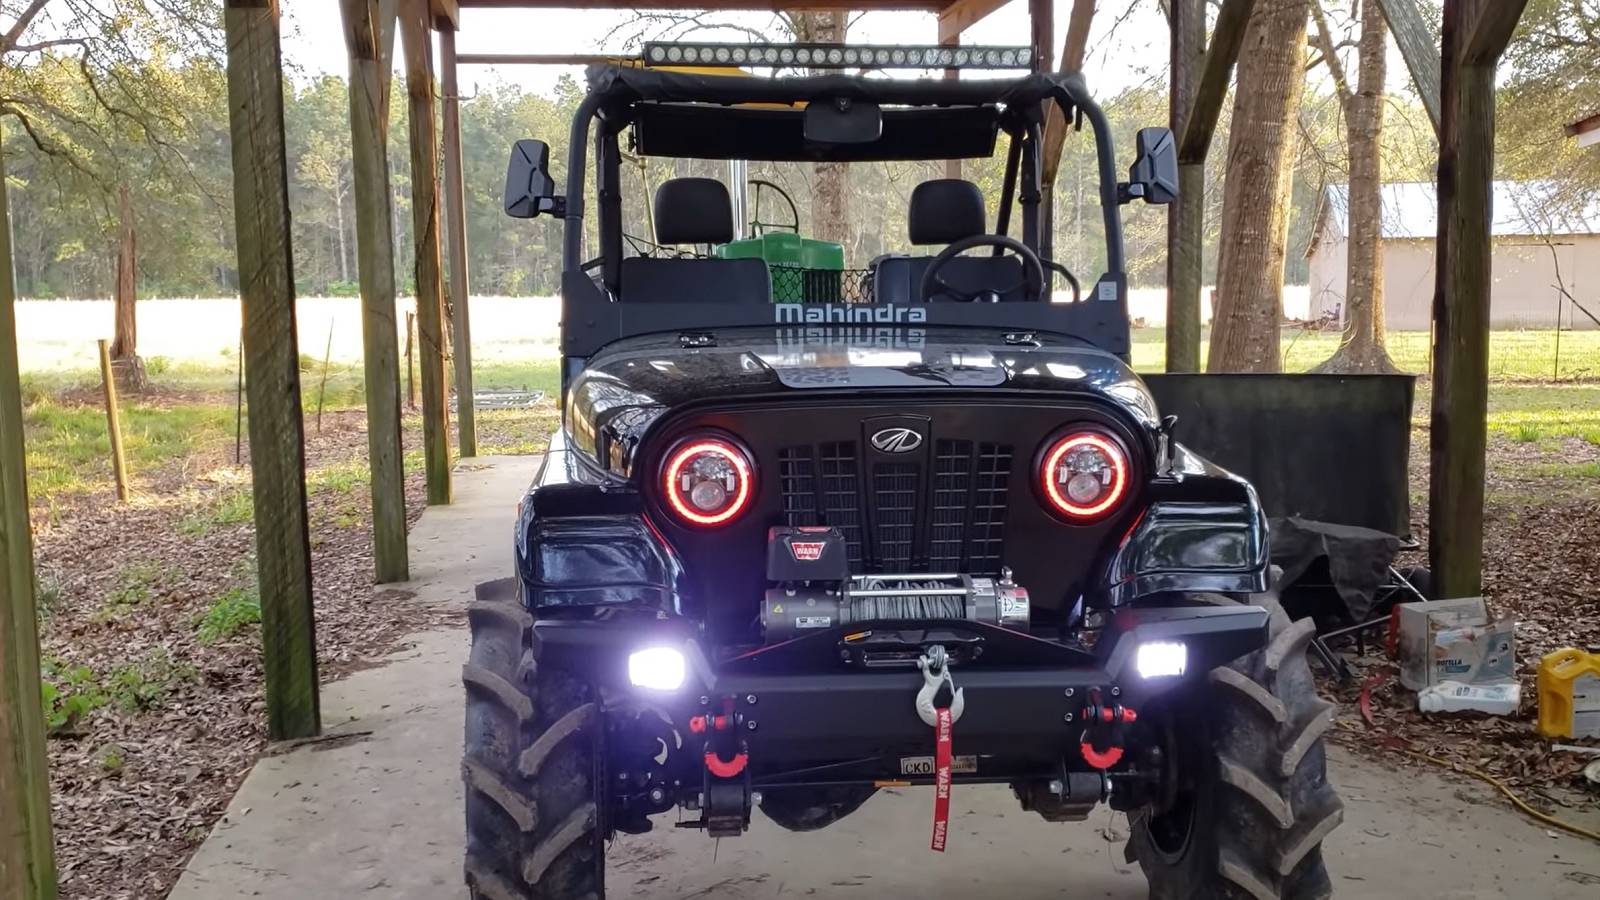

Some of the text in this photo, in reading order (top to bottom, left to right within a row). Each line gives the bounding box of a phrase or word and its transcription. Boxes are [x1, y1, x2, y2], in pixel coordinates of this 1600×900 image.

[939, 710, 951, 742] WARN
[938, 766, 949, 799] WARN
[934, 821, 946, 849] WARN
